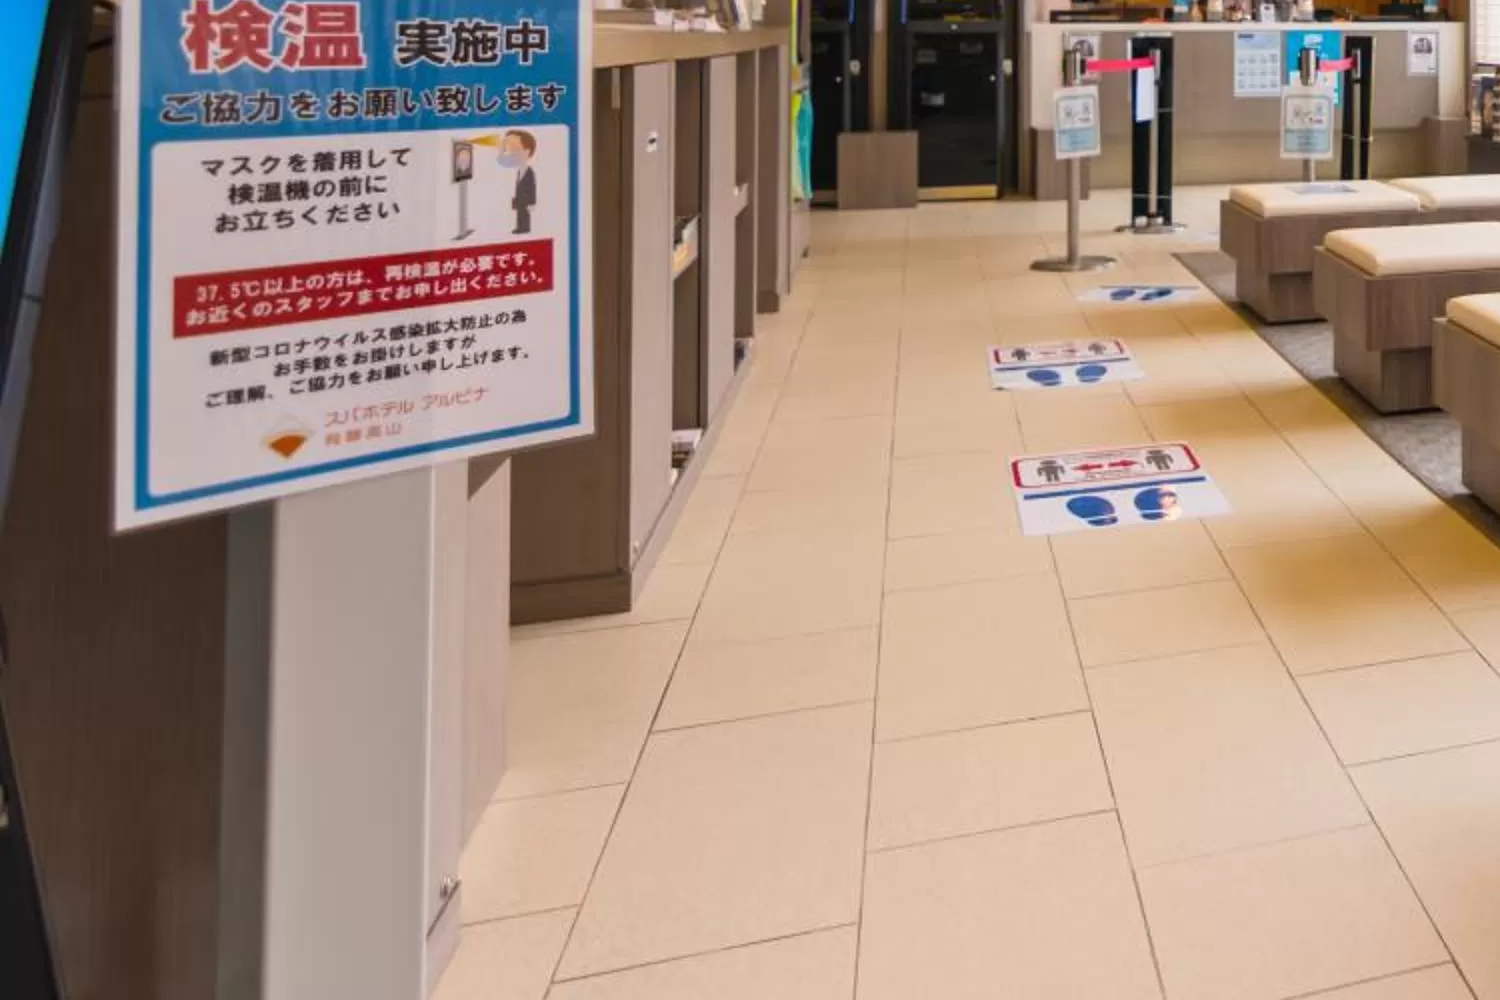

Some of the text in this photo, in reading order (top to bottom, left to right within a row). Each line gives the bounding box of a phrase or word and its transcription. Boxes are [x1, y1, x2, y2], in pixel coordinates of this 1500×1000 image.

[397, 17, 551, 68] 実施中
[159, 82, 567, 125] ご協力をお願い致します
[201, 147, 412, 177] マスクを着用して
[227, 175, 388, 206] 検温機の前に
[214, 201, 401, 234] お立ちください
[273, 333, 477, 378] お手数をお掛けしますが
